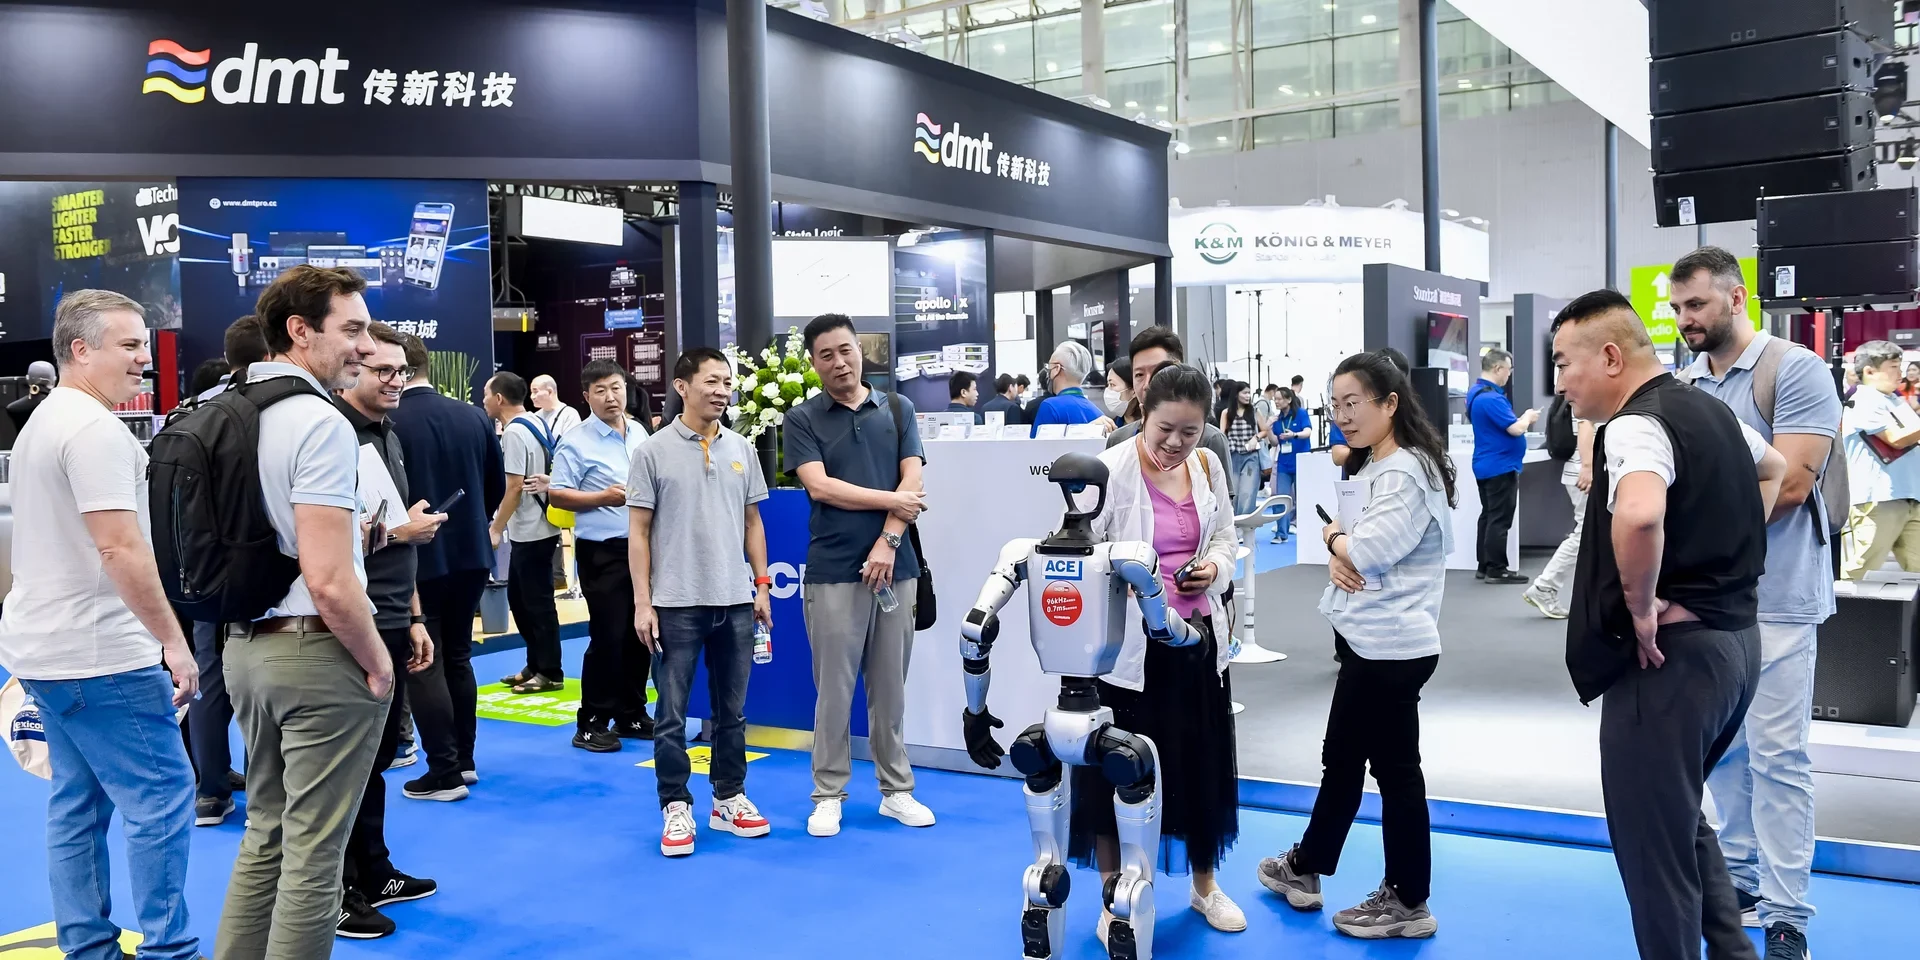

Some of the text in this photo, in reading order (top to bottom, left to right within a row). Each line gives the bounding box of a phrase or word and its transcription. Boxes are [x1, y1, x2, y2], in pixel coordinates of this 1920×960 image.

[211, 43, 349, 105] dmt
[363, 69, 517, 107] 传新科技
[941, 122, 993, 174] dmt
[997, 152, 1051, 187] 传新科技
[52, 189, 104, 212] SMARTER
[222, 199, 277, 208] www.dmtpro.cc
[52, 207, 97, 228] LIGHTER
[53, 224, 93, 244] FASTER
[1255, 232, 1392, 249] KÖNIG & MEYER
[54, 239, 111, 260] STRONGER
[914, 296, 951, 312] apollo
[1045, 560, 1076, 573] ACE
